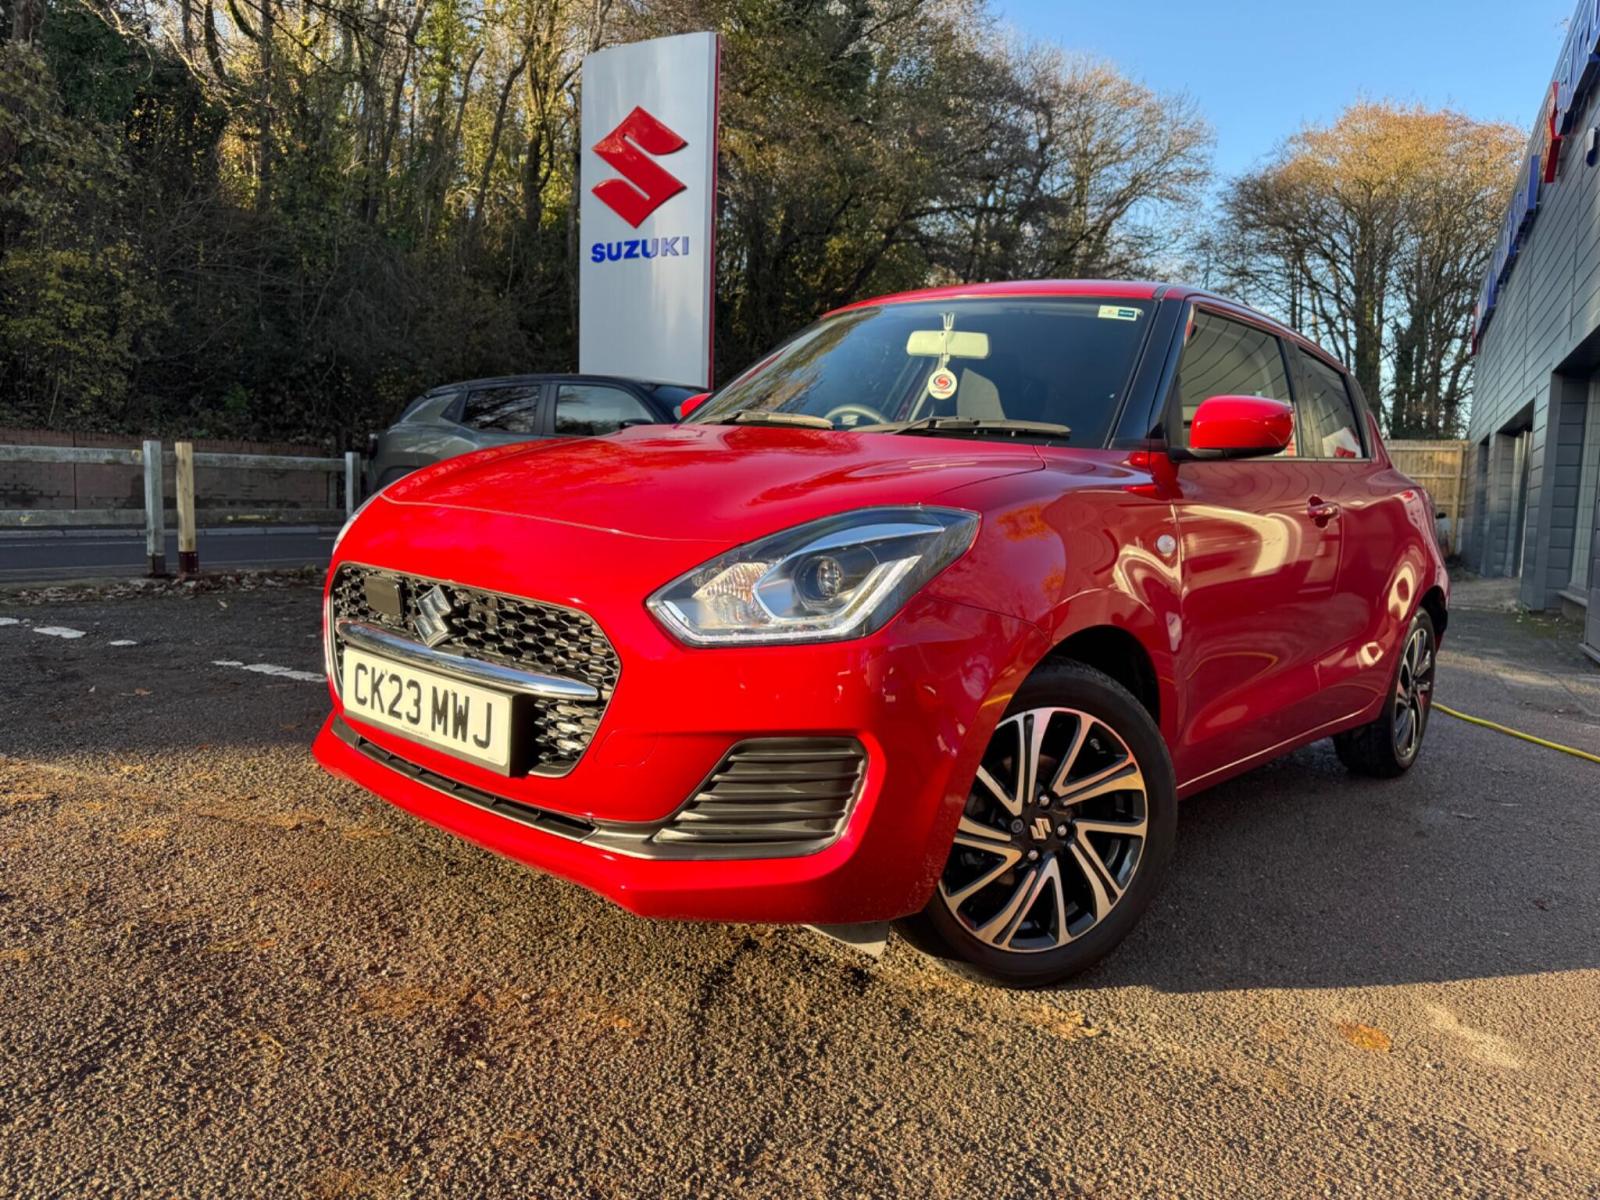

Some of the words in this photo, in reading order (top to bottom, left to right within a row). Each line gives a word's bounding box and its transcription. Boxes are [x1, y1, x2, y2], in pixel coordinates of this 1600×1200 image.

[591, 236, 690, 263] SUZUKI
[354, 662, 422, 726] CK23
[431, 685, 492, 750] MWJ
